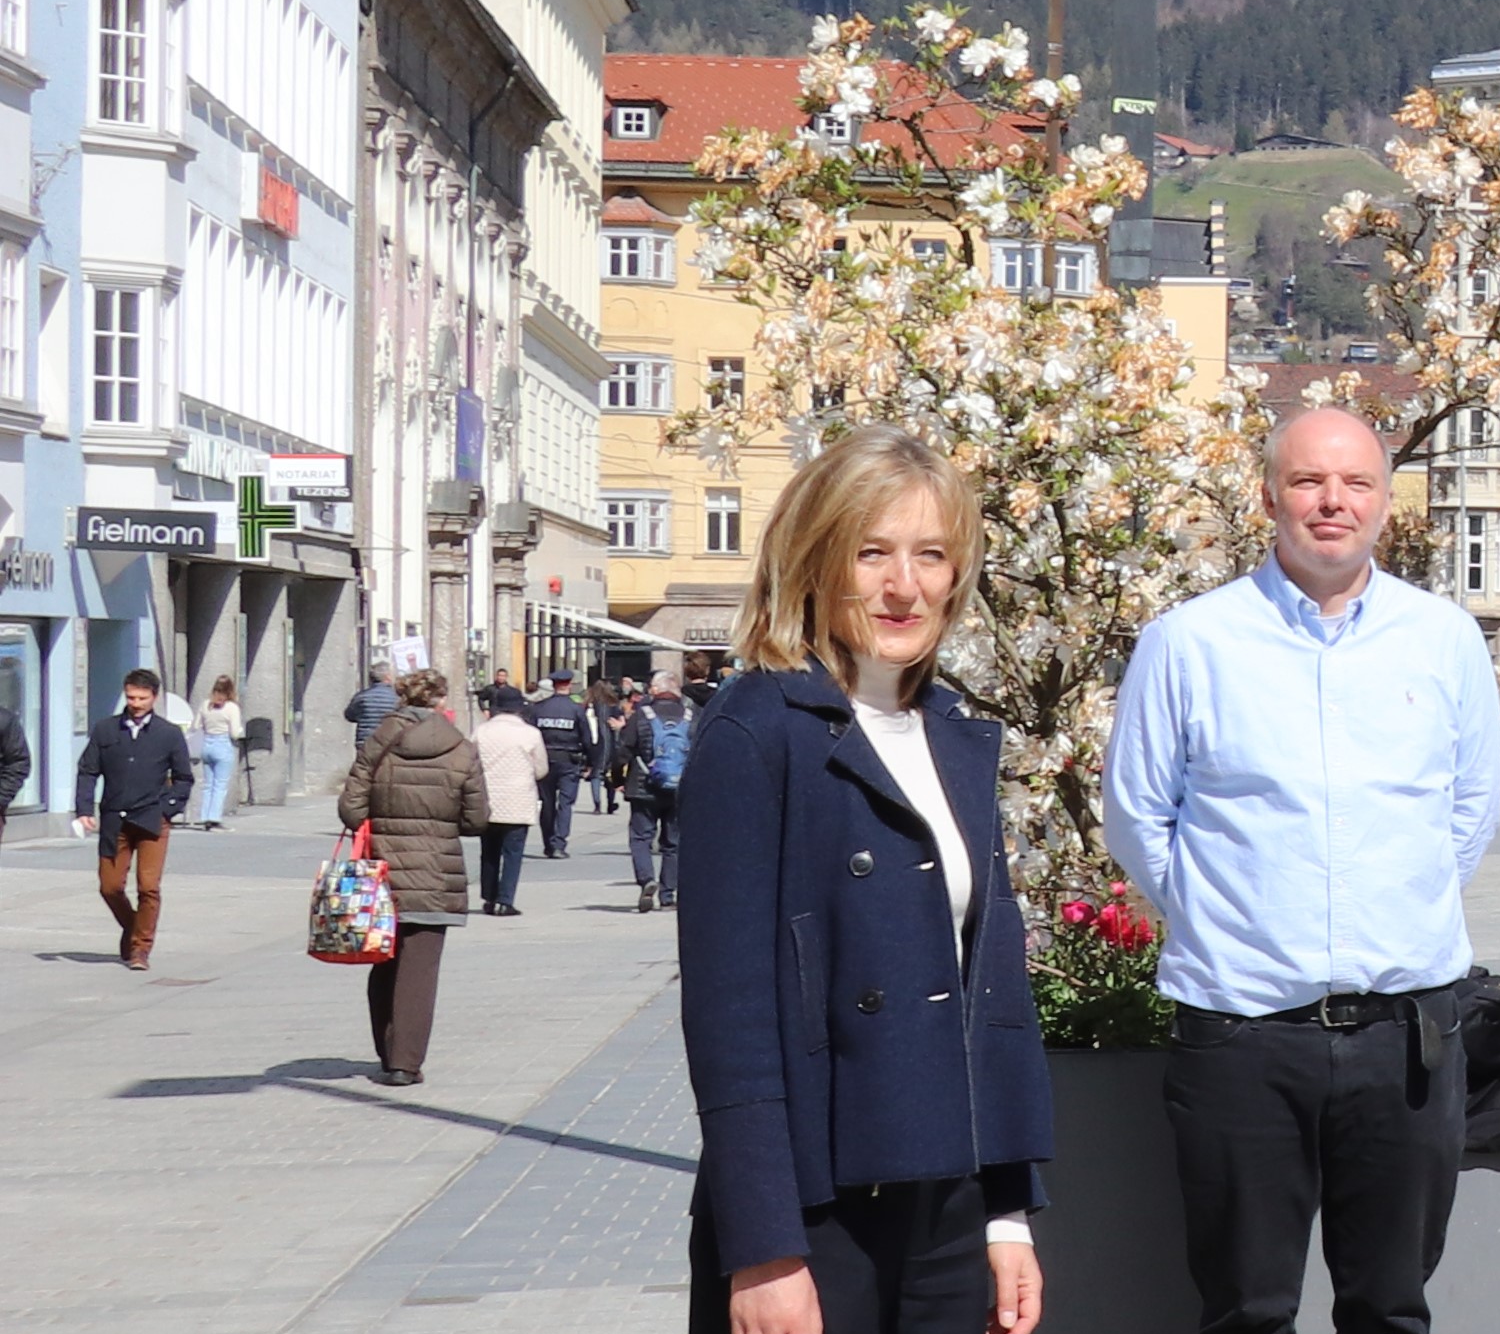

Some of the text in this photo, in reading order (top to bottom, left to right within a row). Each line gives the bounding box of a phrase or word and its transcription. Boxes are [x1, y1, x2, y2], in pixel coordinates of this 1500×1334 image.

[276, 470, 338, 479] NOTARIAT
[87, 515, 205, 547] fielmann
[537, 718, 574, 730] POLIZEI
